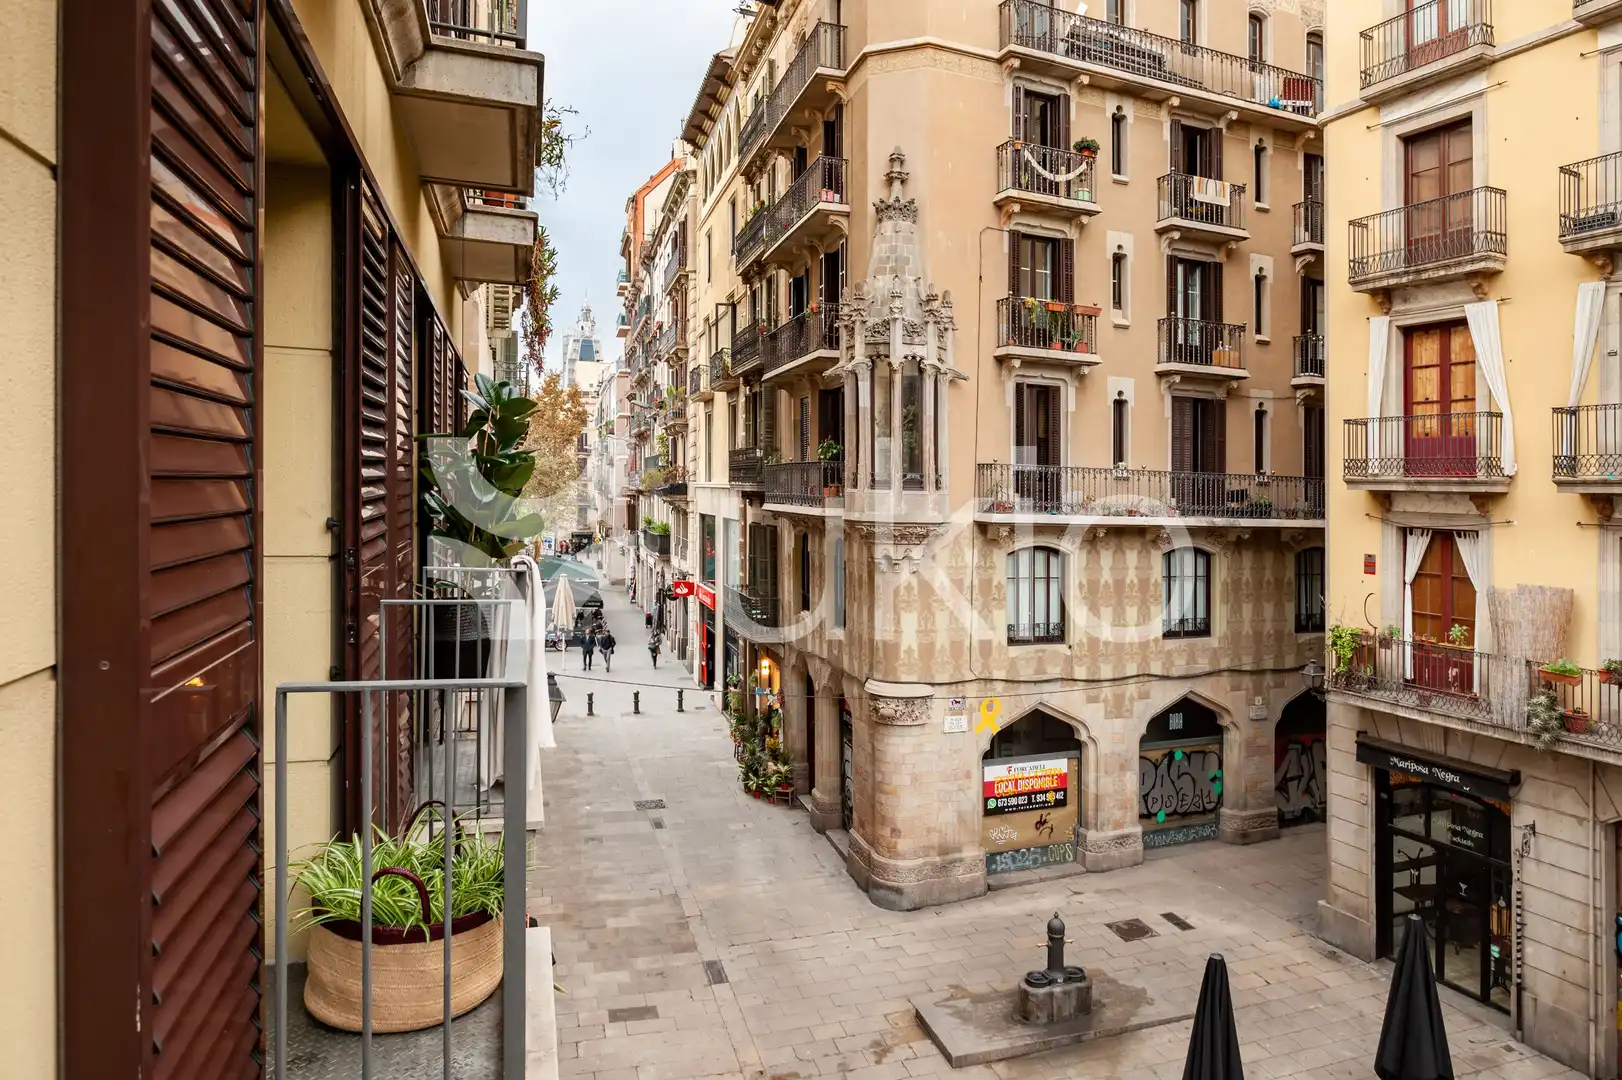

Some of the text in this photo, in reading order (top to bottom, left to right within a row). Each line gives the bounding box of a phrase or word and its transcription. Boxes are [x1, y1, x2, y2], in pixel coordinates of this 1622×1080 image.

[1389, 755, 1460, 783] Mariposa Negra
[995, 776, 1058, 794] LOCAL DISPONIBLE
